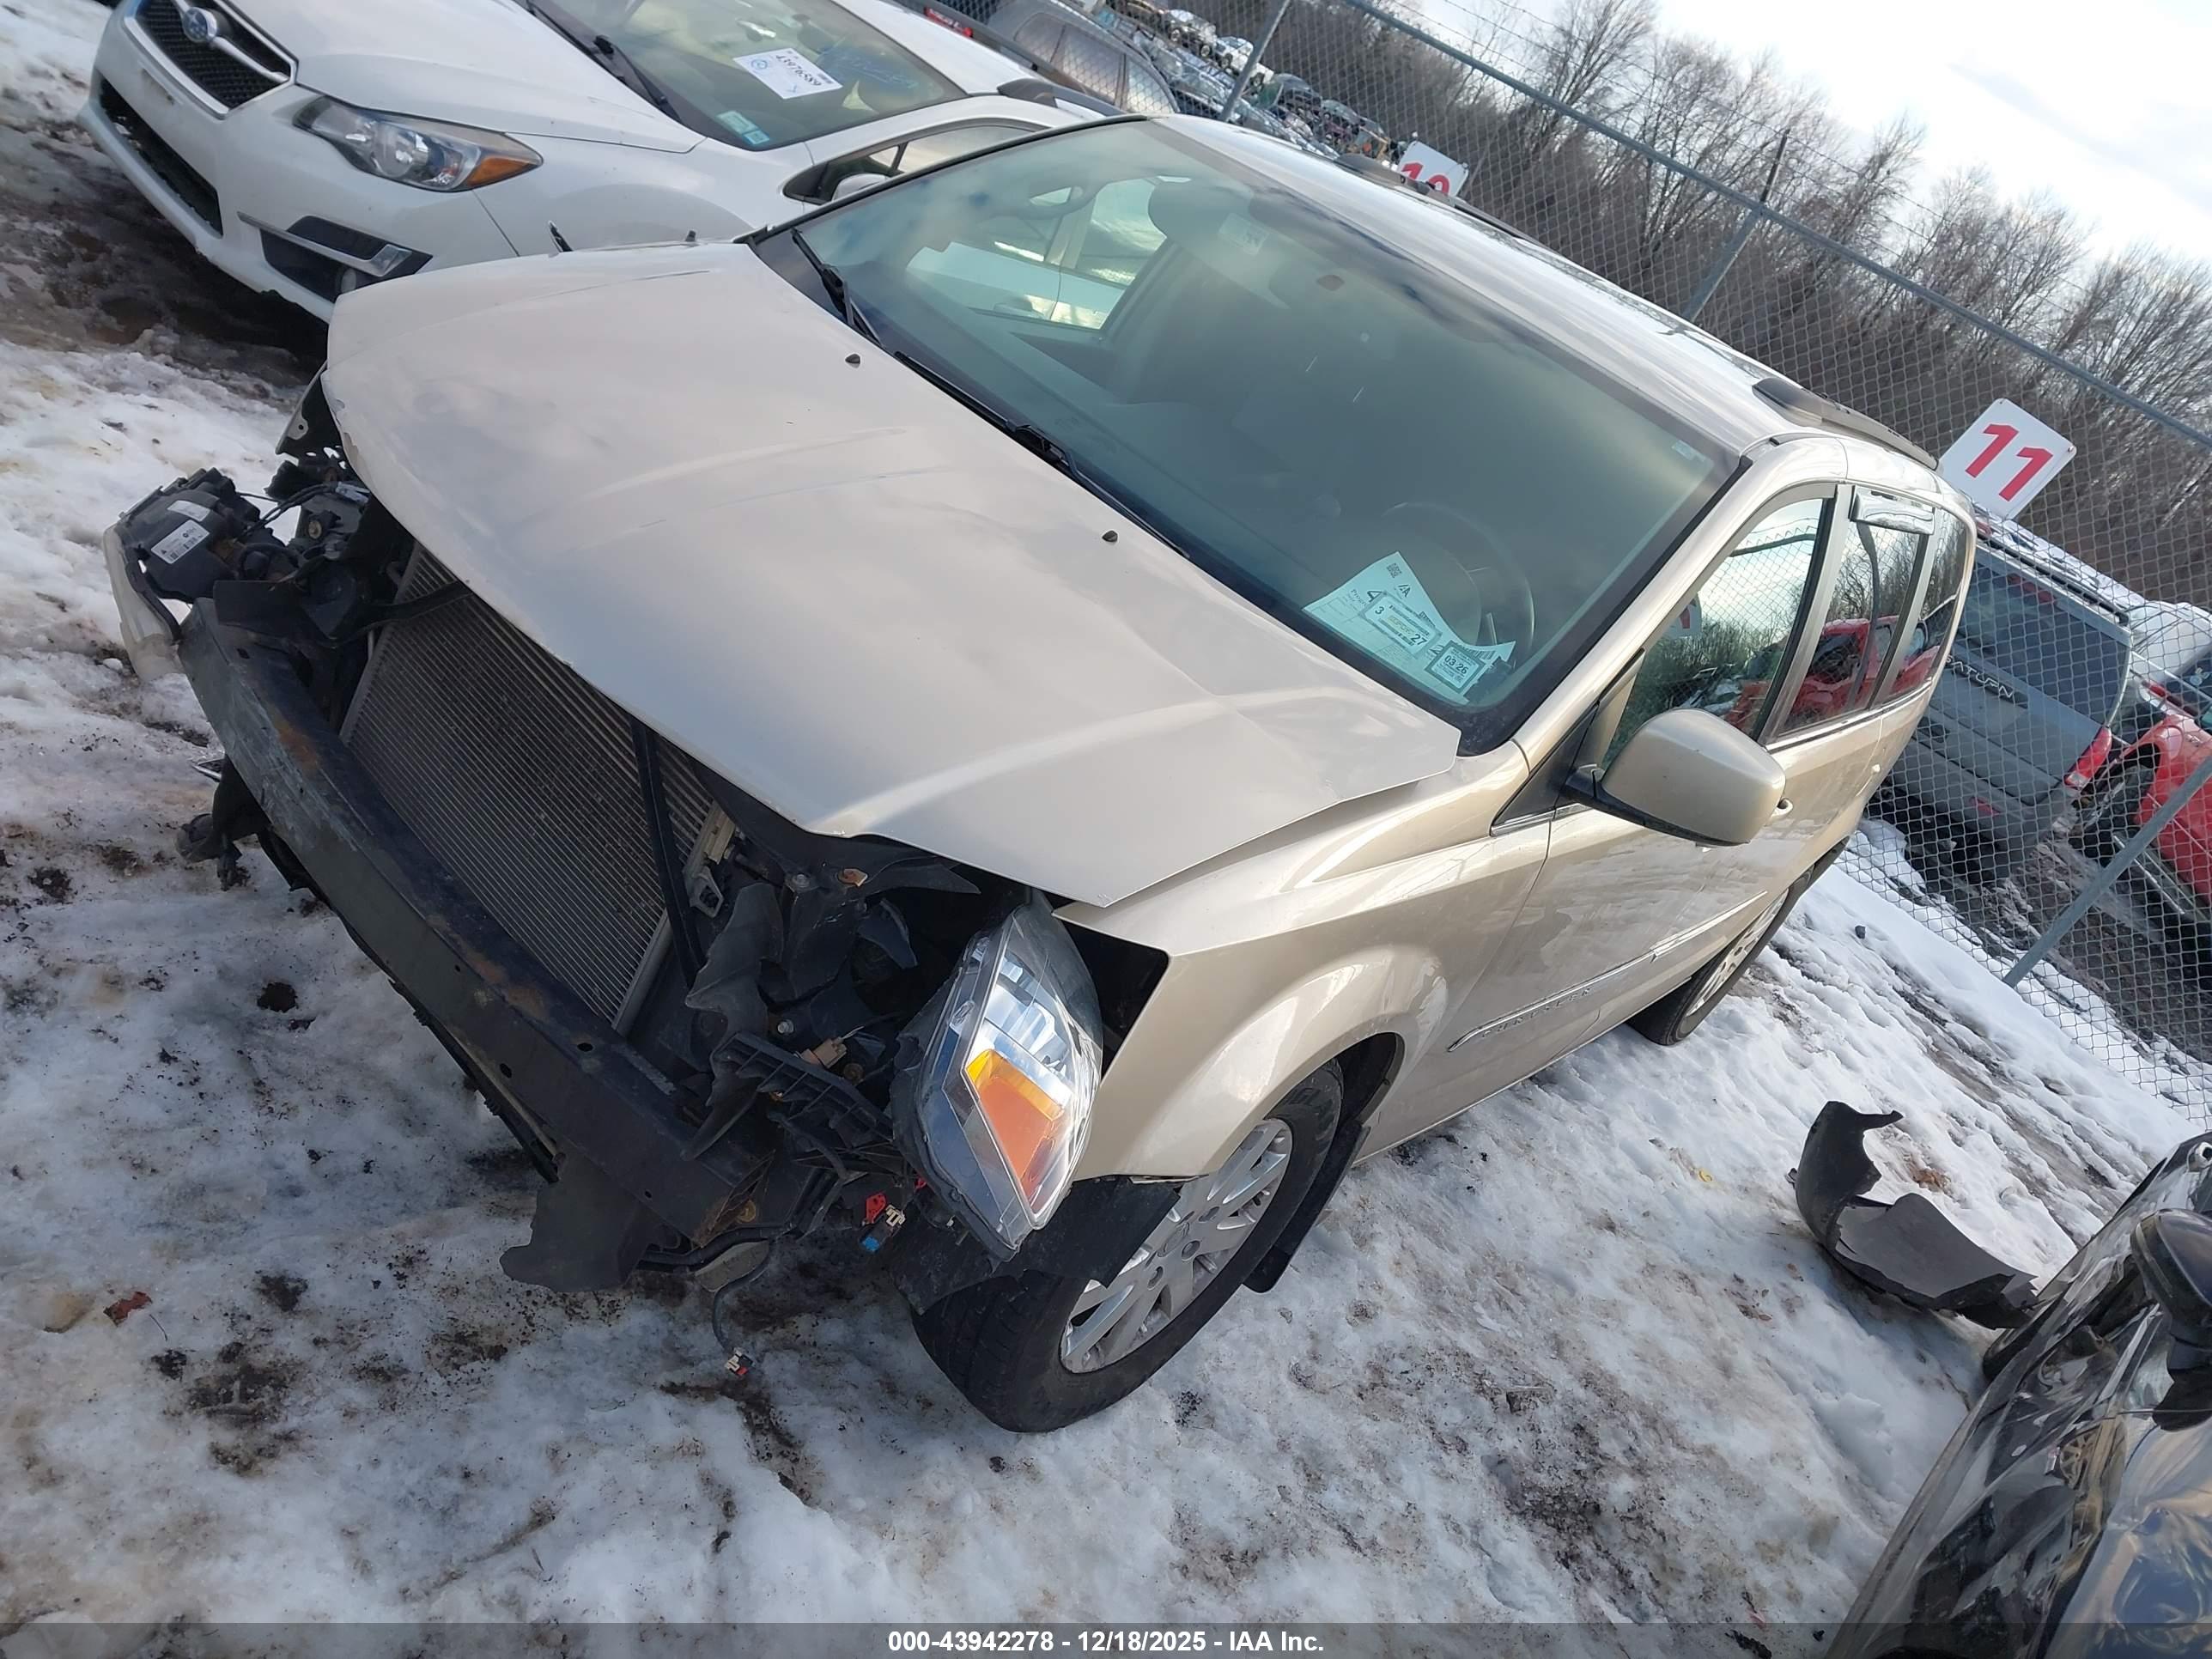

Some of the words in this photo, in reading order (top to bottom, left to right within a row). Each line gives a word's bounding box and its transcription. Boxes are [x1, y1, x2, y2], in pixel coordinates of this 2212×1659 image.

[1965, 422, 2054, 503] 11
[1375, 605, 1385, 616] 3
[1411, 632, 1428, 647] 27
[1455, 662, 1468, 676] 26
[1946, 653, 2014, 699] SATURN
